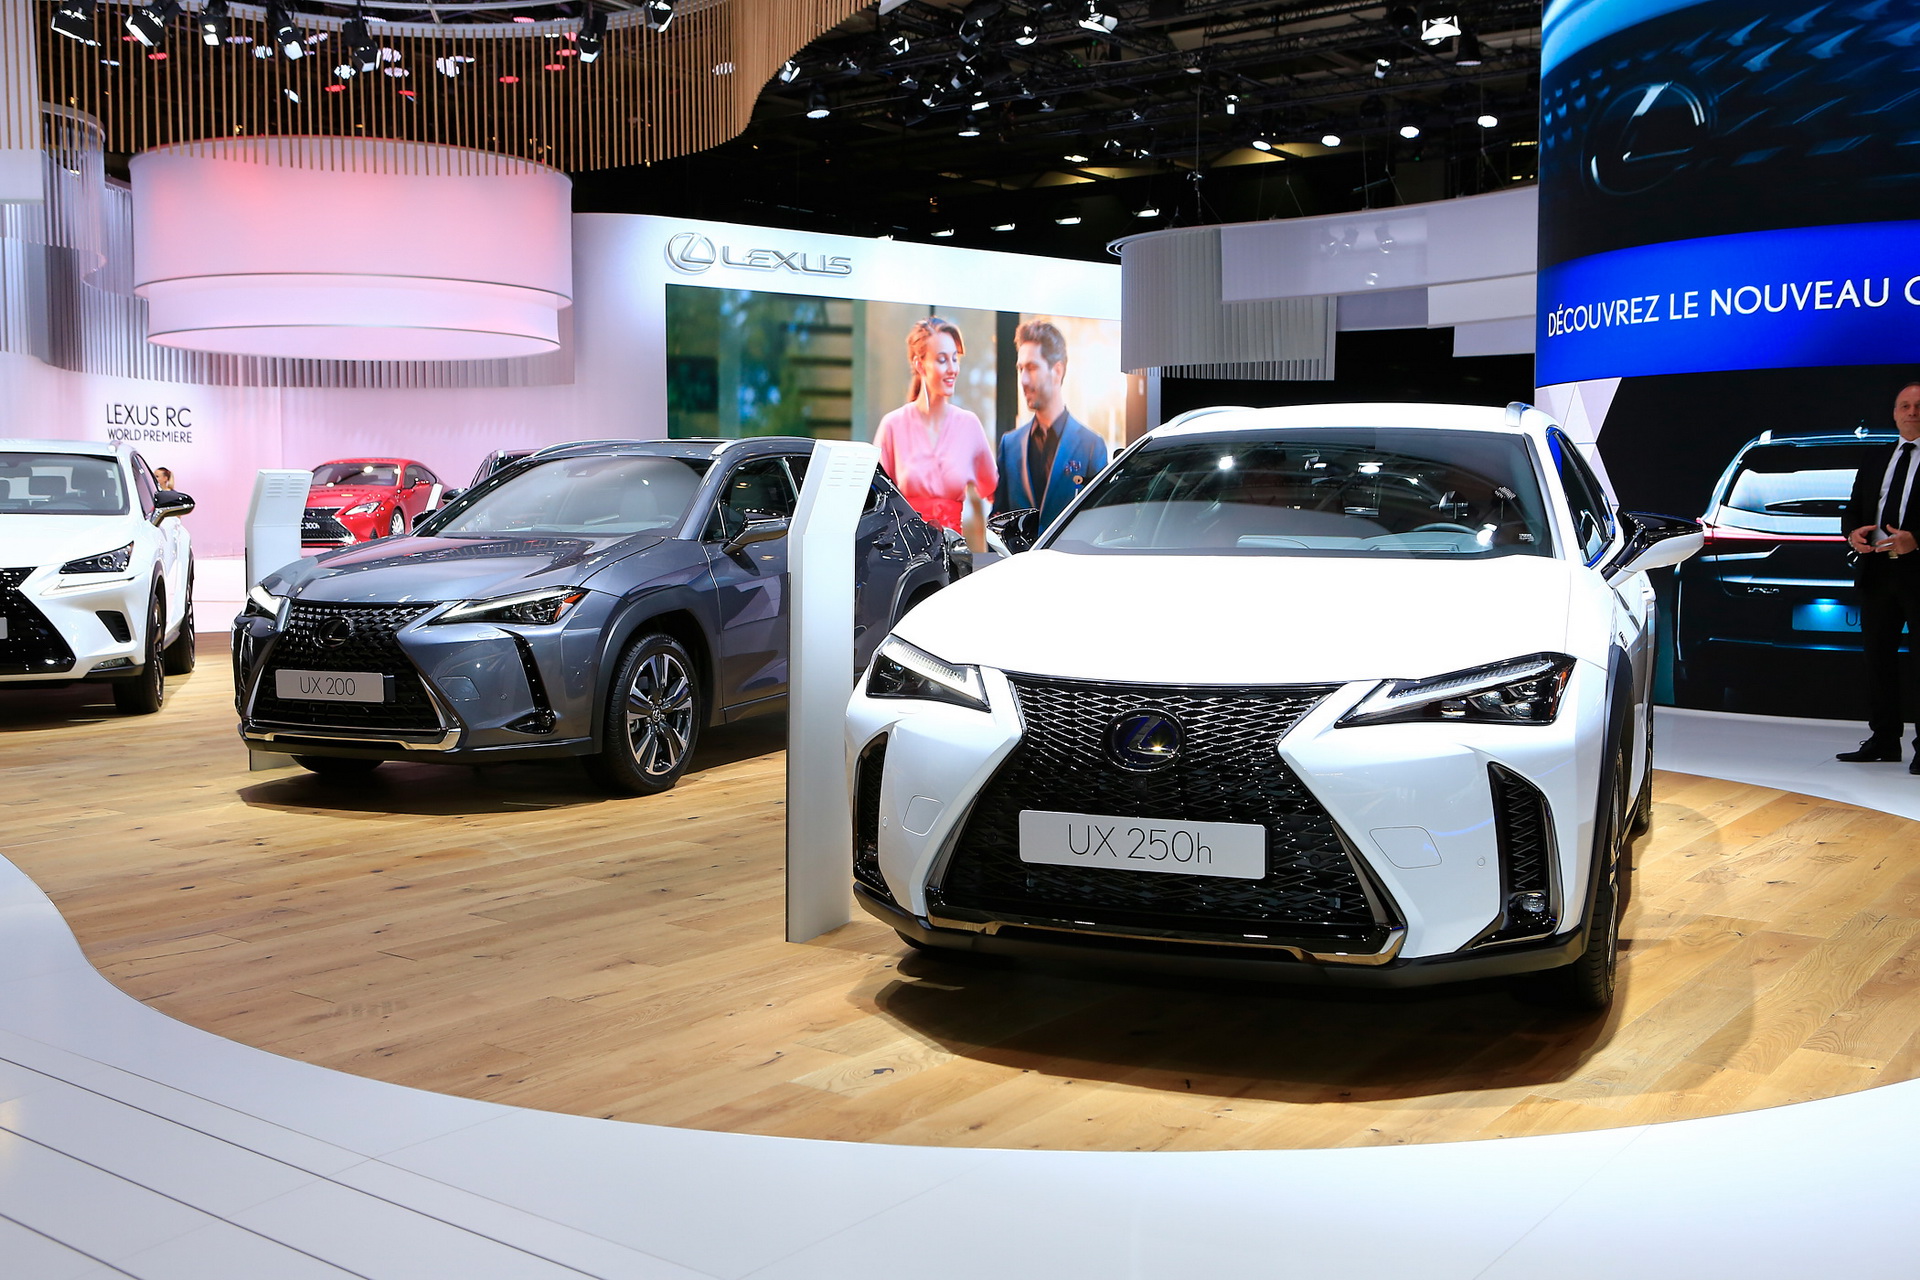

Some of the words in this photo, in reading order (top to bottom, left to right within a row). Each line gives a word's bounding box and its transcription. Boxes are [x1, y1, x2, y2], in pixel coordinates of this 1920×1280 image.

[720, 245, 853, 277] LEXUS
[1548, 294, 1660, 337] DÉCOUVREZ
[1669, 290, 1698, 320] LE
[1710, 277, 1890, 317] NOUVEAU
[106, 403, 160, 427] LEXUS
[165, 407, 192, 428] RC
[107, 428, 142, 441] WORLD
[143, 429, 193, 443] PREMIERE
[304, 522, 320, 530] 300h
[299, 676, 323, 695] UX
[325, 677, 356, 696] 200
[1068, 823, 1117, 858] UX
[1127, 828, 1212, 864] 250h
